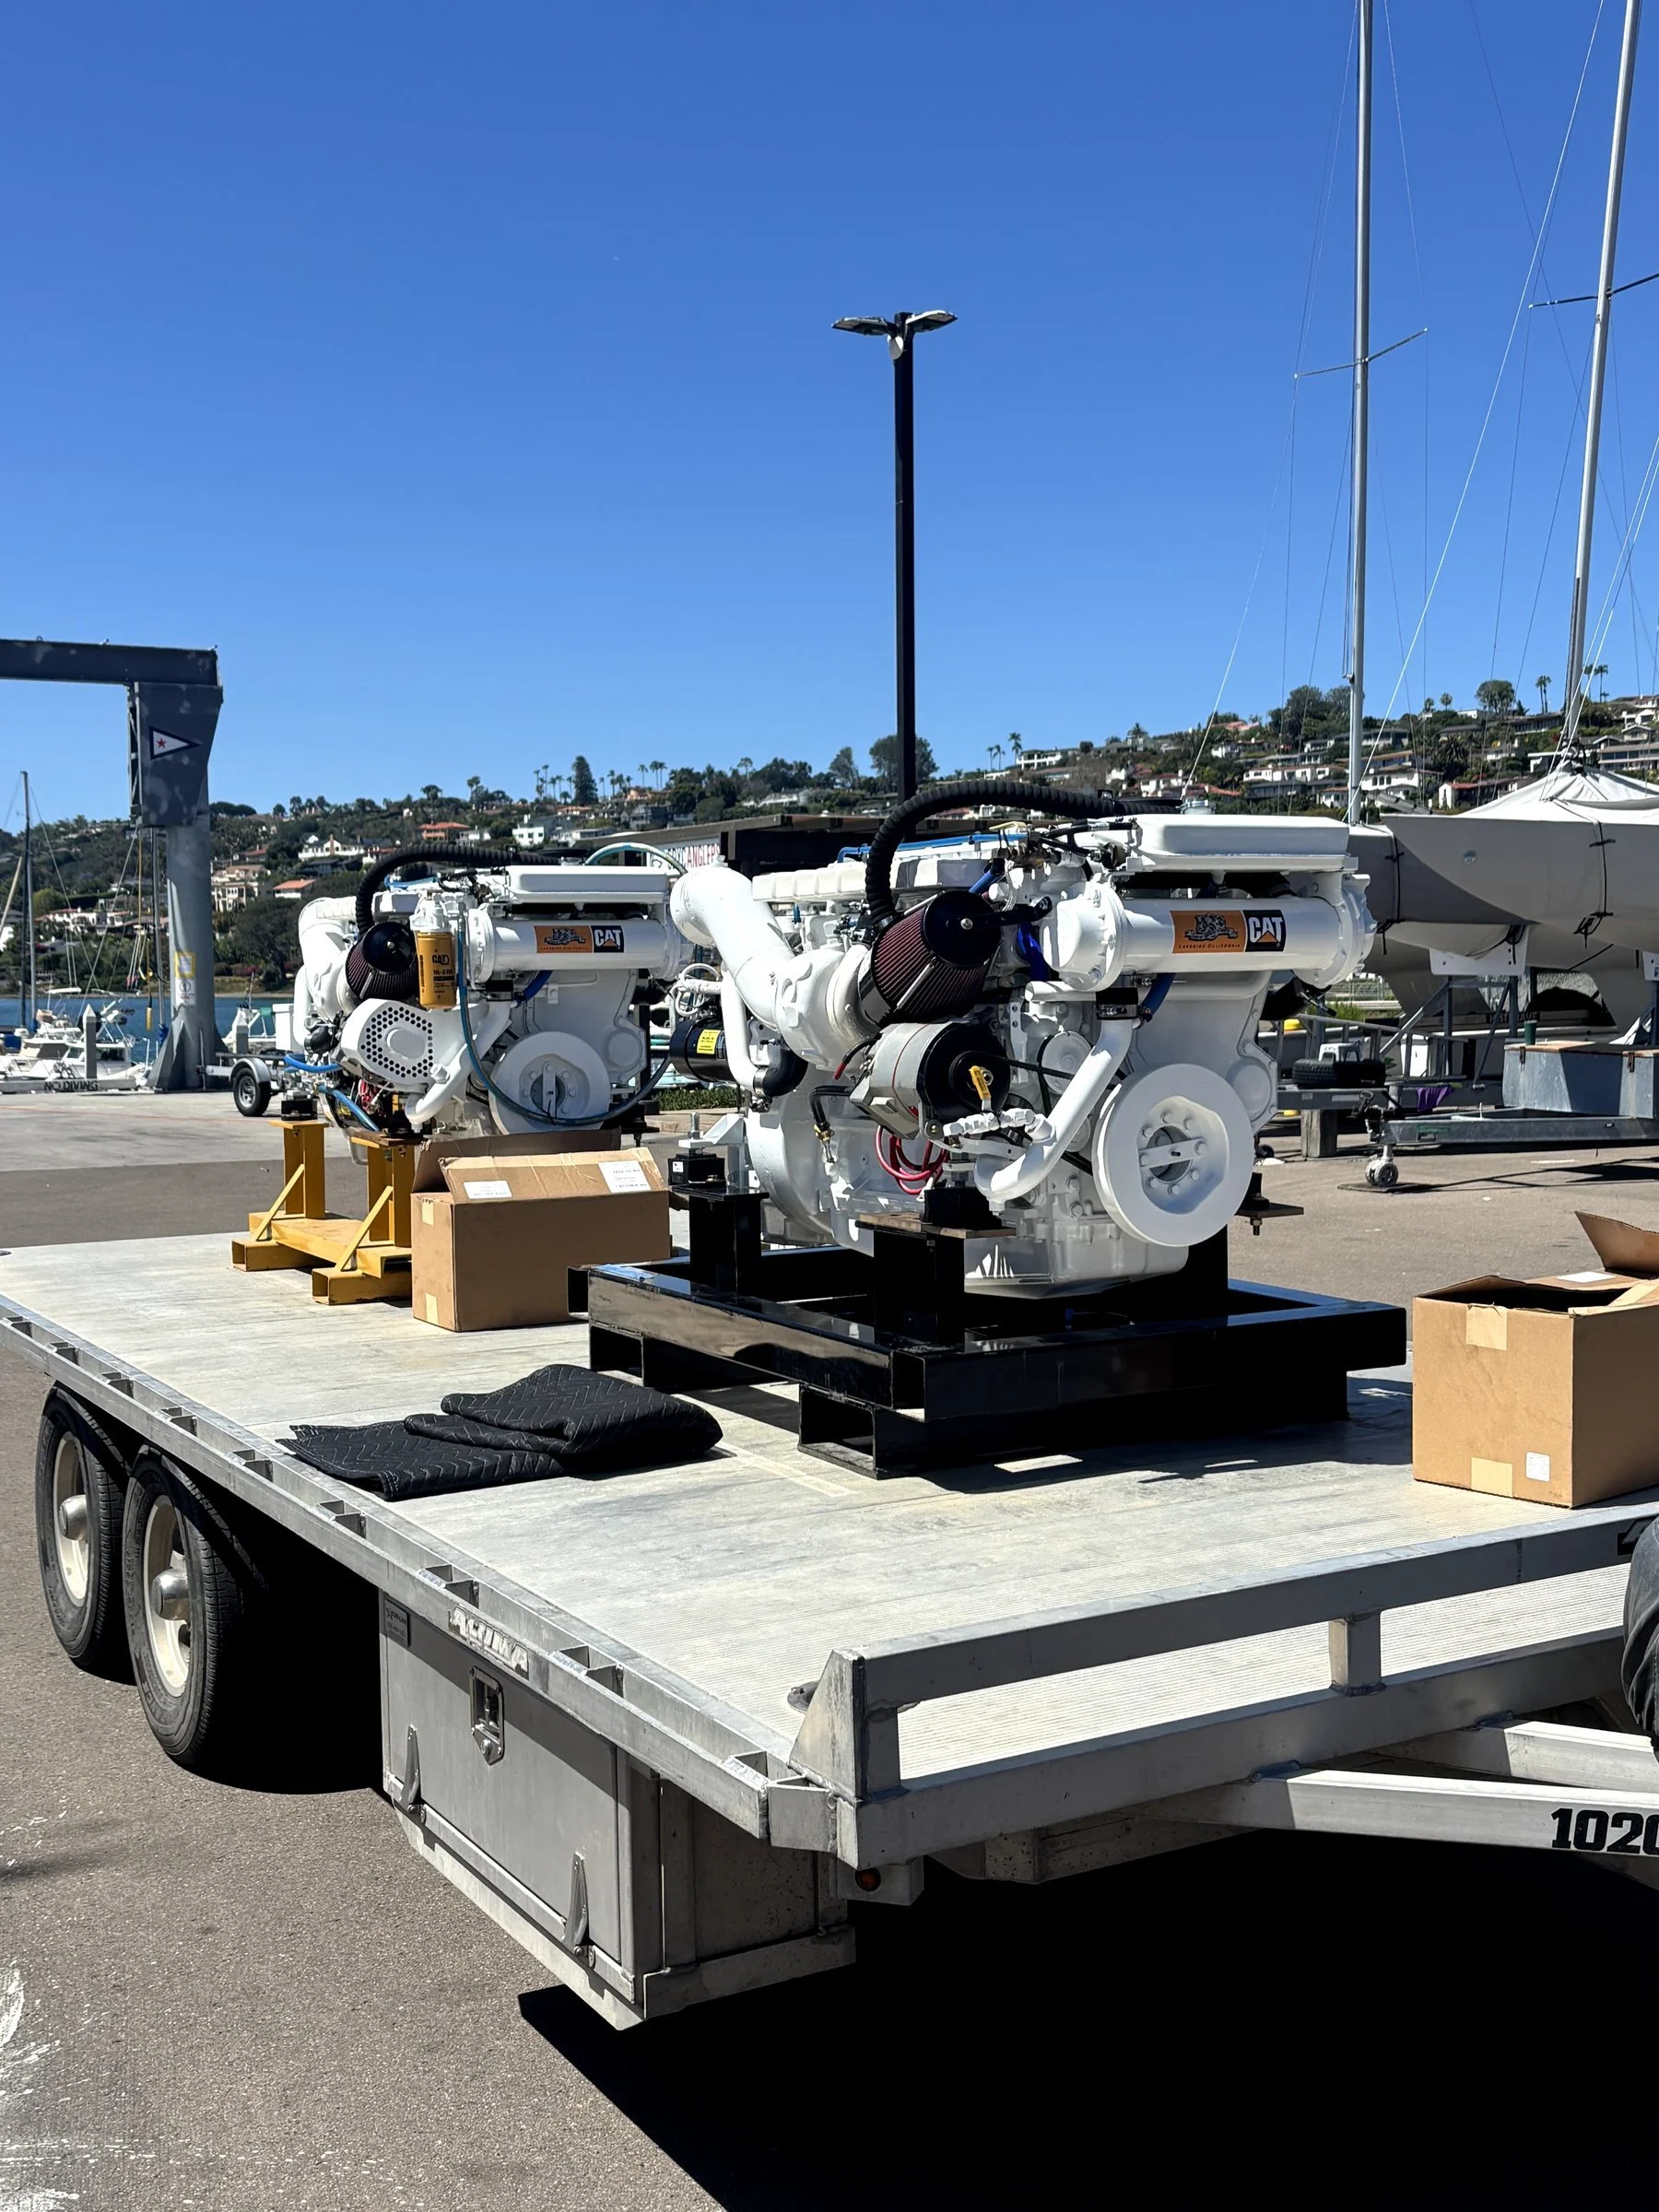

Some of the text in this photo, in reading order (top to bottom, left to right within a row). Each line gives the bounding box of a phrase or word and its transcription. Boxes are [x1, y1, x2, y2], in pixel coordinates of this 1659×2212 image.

[594, 929, 622, 948] CAT
[1248, 916, 1282, 943] CAT
[43, 1080, 98, 1091] NO DIVING
